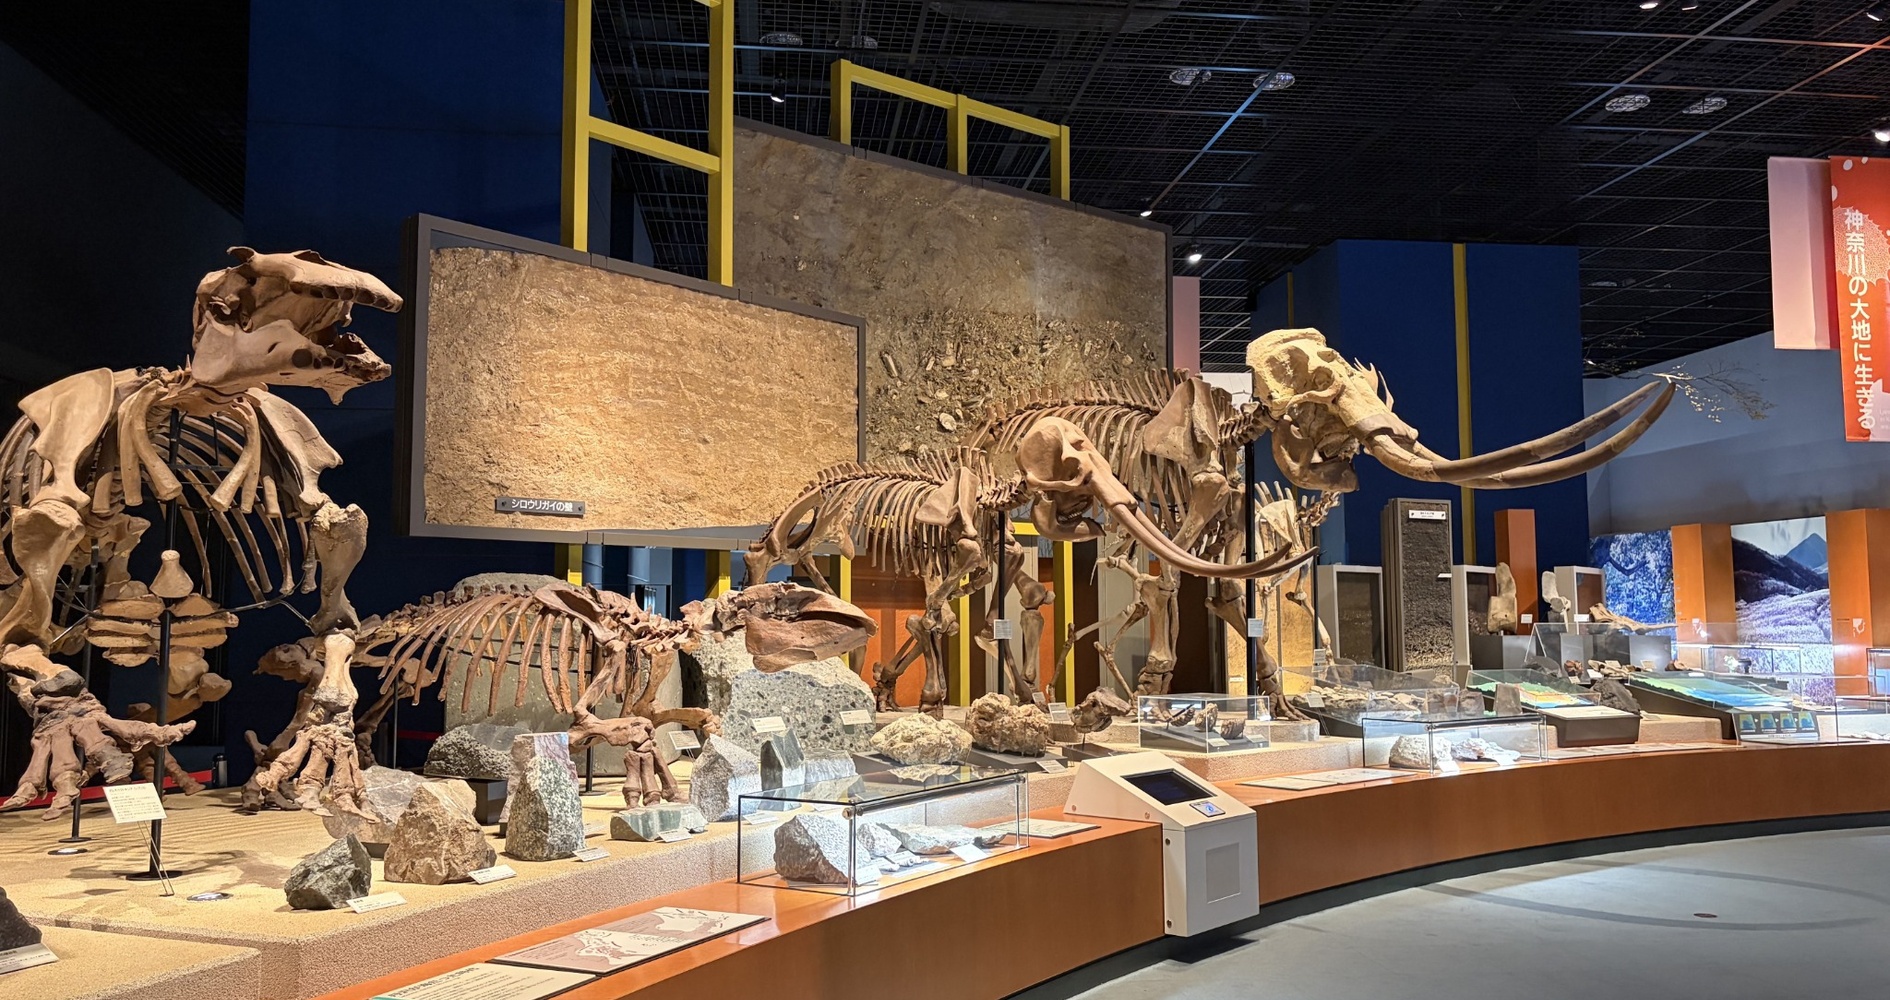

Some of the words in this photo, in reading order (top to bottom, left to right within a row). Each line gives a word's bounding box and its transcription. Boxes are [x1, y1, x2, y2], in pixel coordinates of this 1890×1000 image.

[1844, 209, 1876, 430] 神奈川の大地に生きる
[511, 499, 573, 512] シロウリガイの壁
